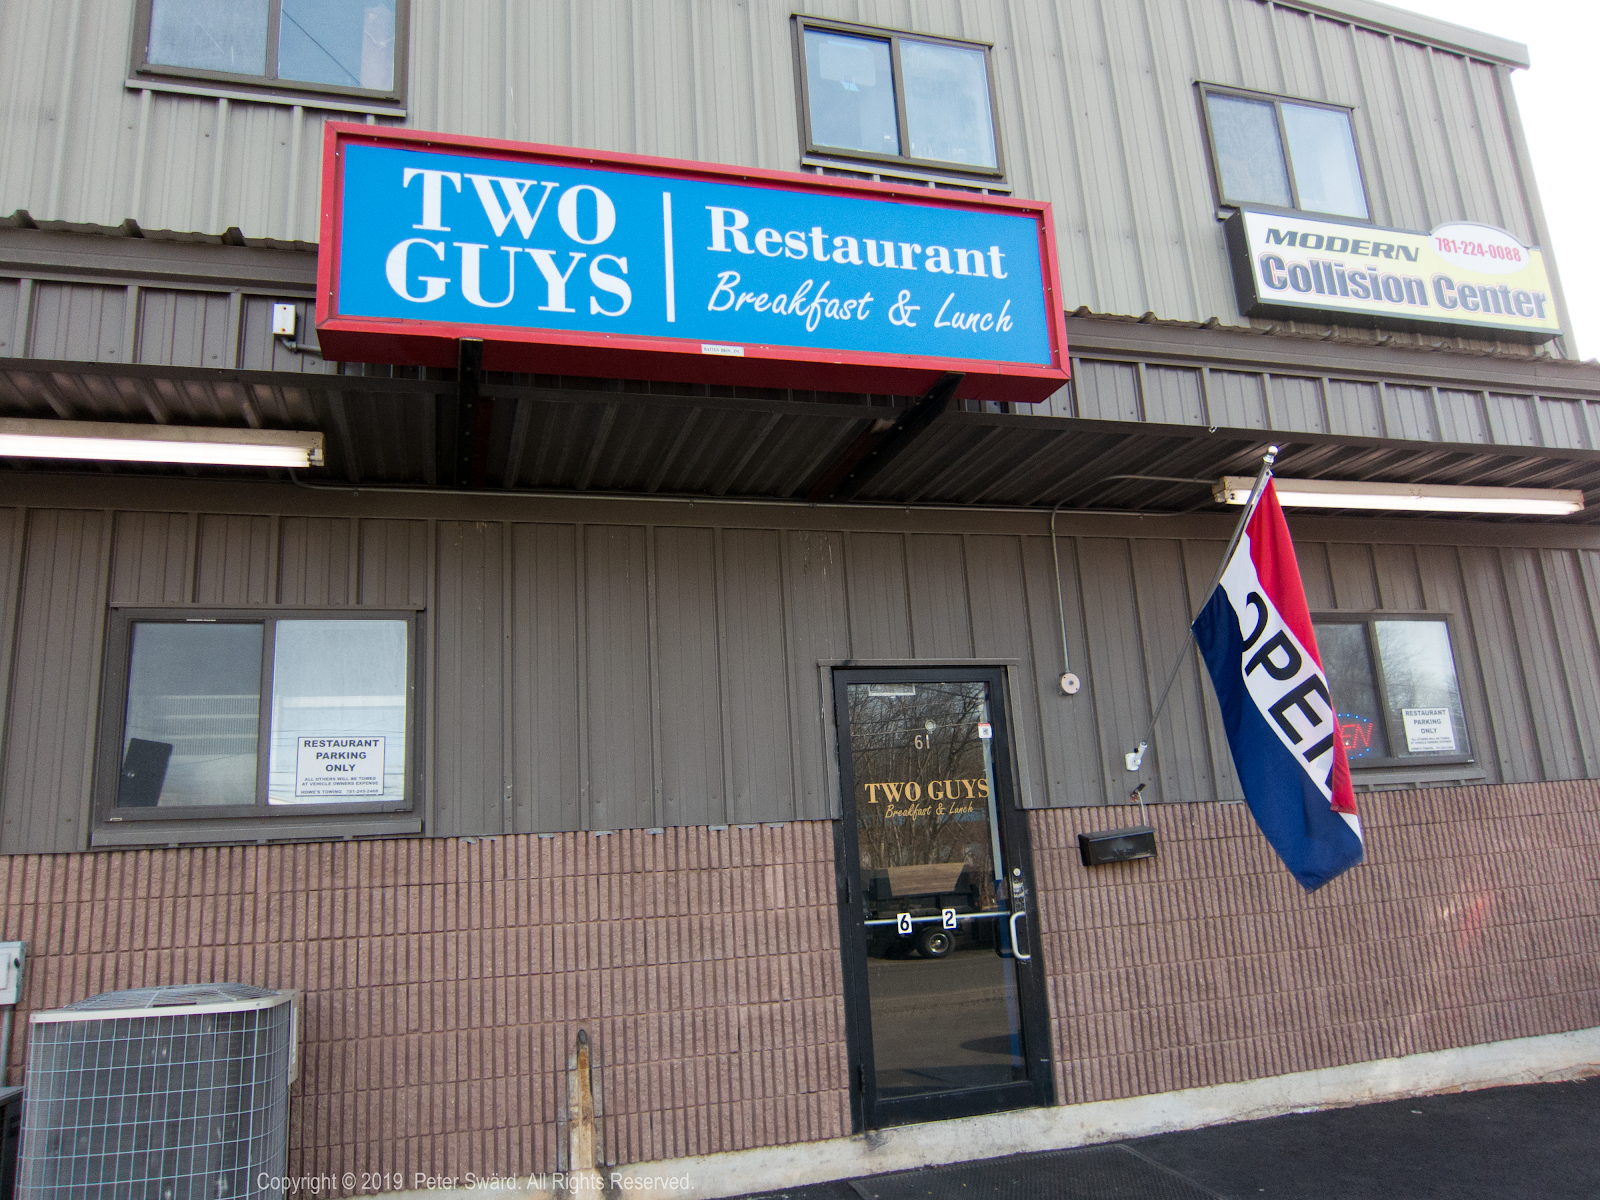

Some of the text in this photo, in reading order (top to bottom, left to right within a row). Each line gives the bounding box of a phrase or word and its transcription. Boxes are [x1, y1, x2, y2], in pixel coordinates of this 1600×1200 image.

[402, 168, 616, 246] TWO
[705, 205, 1008, 280] Restaurant
[1265, 228, 1420, 263] MODERN
[1435, 236, 1522, 263] 781-224-0088
[385, 237, 632, 317] GUYS
[1259, 252, 1548, 320] Collision Center
[707, 271, 1013, 333] Breakfast & Lunch
[1243, 591, 1335, 791] OPE
[303, 739, 379, 748] RESTAURANT
[914, 734, 930, 750] 61
[316, 752, 367, 760] PARKING
[325, 764, 356, 772] ONLY
[864, 778, 990, 804] TWO GUYS
[885, 801, 973, 821] Breakfast & Lunch
[900, 911, 954, 931] 6 2
